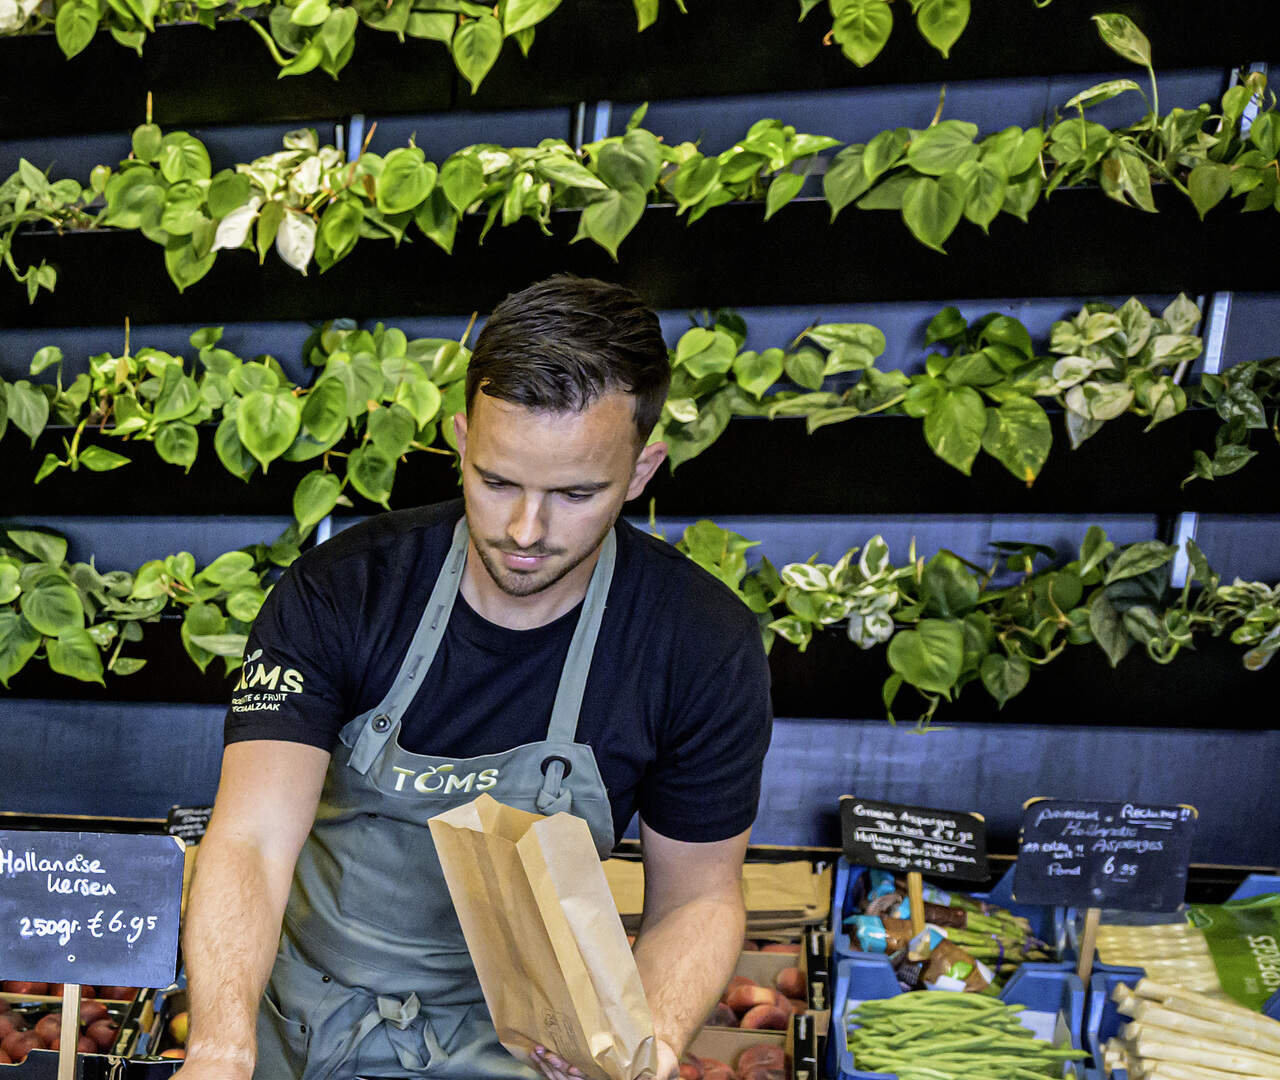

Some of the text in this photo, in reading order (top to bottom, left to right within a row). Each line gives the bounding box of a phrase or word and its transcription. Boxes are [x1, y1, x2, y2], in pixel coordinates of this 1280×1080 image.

[233, 648, 304, 694] OMS
[263, 694, 288, 702] FRUIT
[393, 764, 499, 794] TOMS
